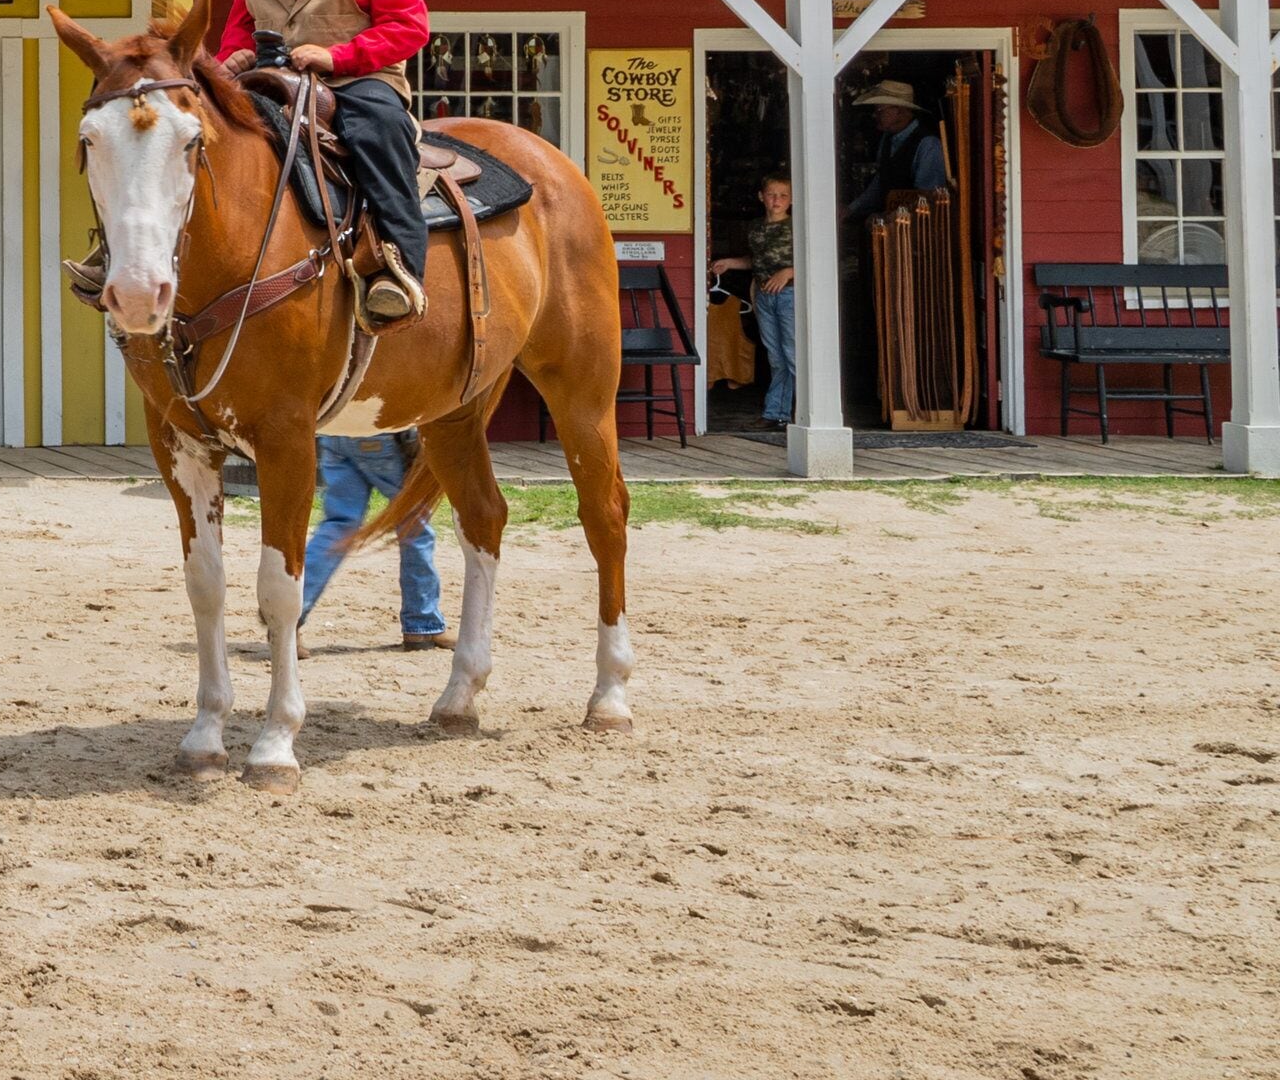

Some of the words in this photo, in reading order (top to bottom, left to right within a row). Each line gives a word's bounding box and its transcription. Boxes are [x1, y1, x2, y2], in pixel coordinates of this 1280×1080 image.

[627, 57, 658, 70] The
[601, 67, 682, 86] COWBOY
[606, 87, 676, 107] STORE
[657, 116, 682, 124] GIFTS
[646, 125, 682, 134] JEWELRY
[597, 104, 684, 209] SOUVINERS
[601, 173, 624, 181] BELTS
[602, 193, 631, 201] SPURS
[601, 203, 620, 211] CAP
[621, 203, 648, 211] GUNS
